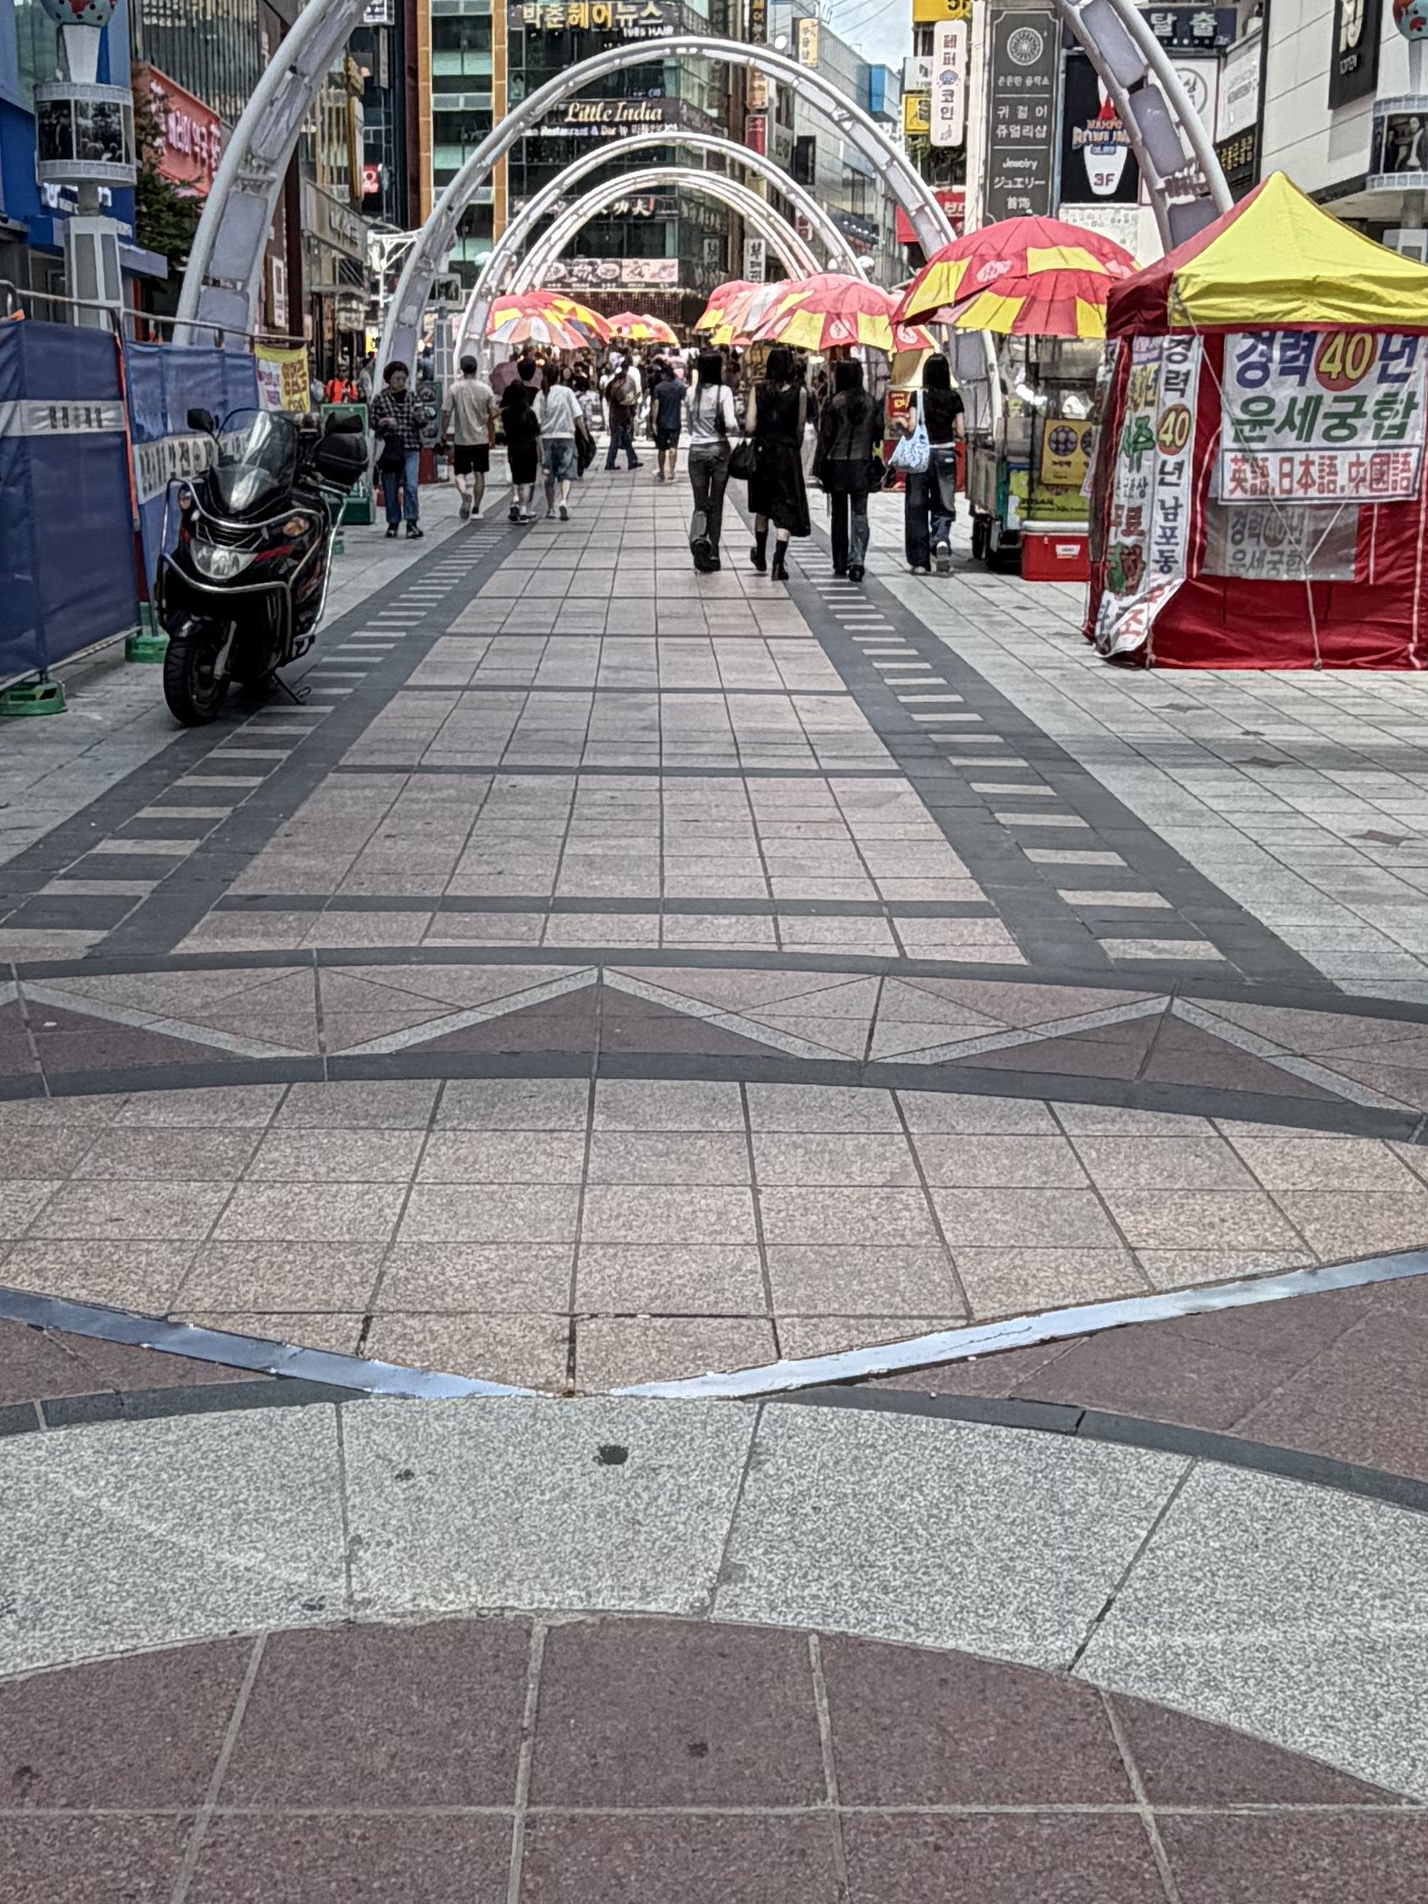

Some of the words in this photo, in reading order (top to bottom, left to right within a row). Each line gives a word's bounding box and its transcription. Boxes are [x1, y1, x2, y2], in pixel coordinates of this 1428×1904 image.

[564, 101, 613, 123] Little
[615, 101, 663, 122] India
[996, 104, 1048, 120] 귀걸이
[995, 123, 1048, 139] 쥬얼리샵
[1093, 172, 1115, 187] 3F
[1236, 331, 1319, 389] 경력
[1231, 390, 1419, 444] 운세궁합
[1152, 496, 1184, 574] 남포동
